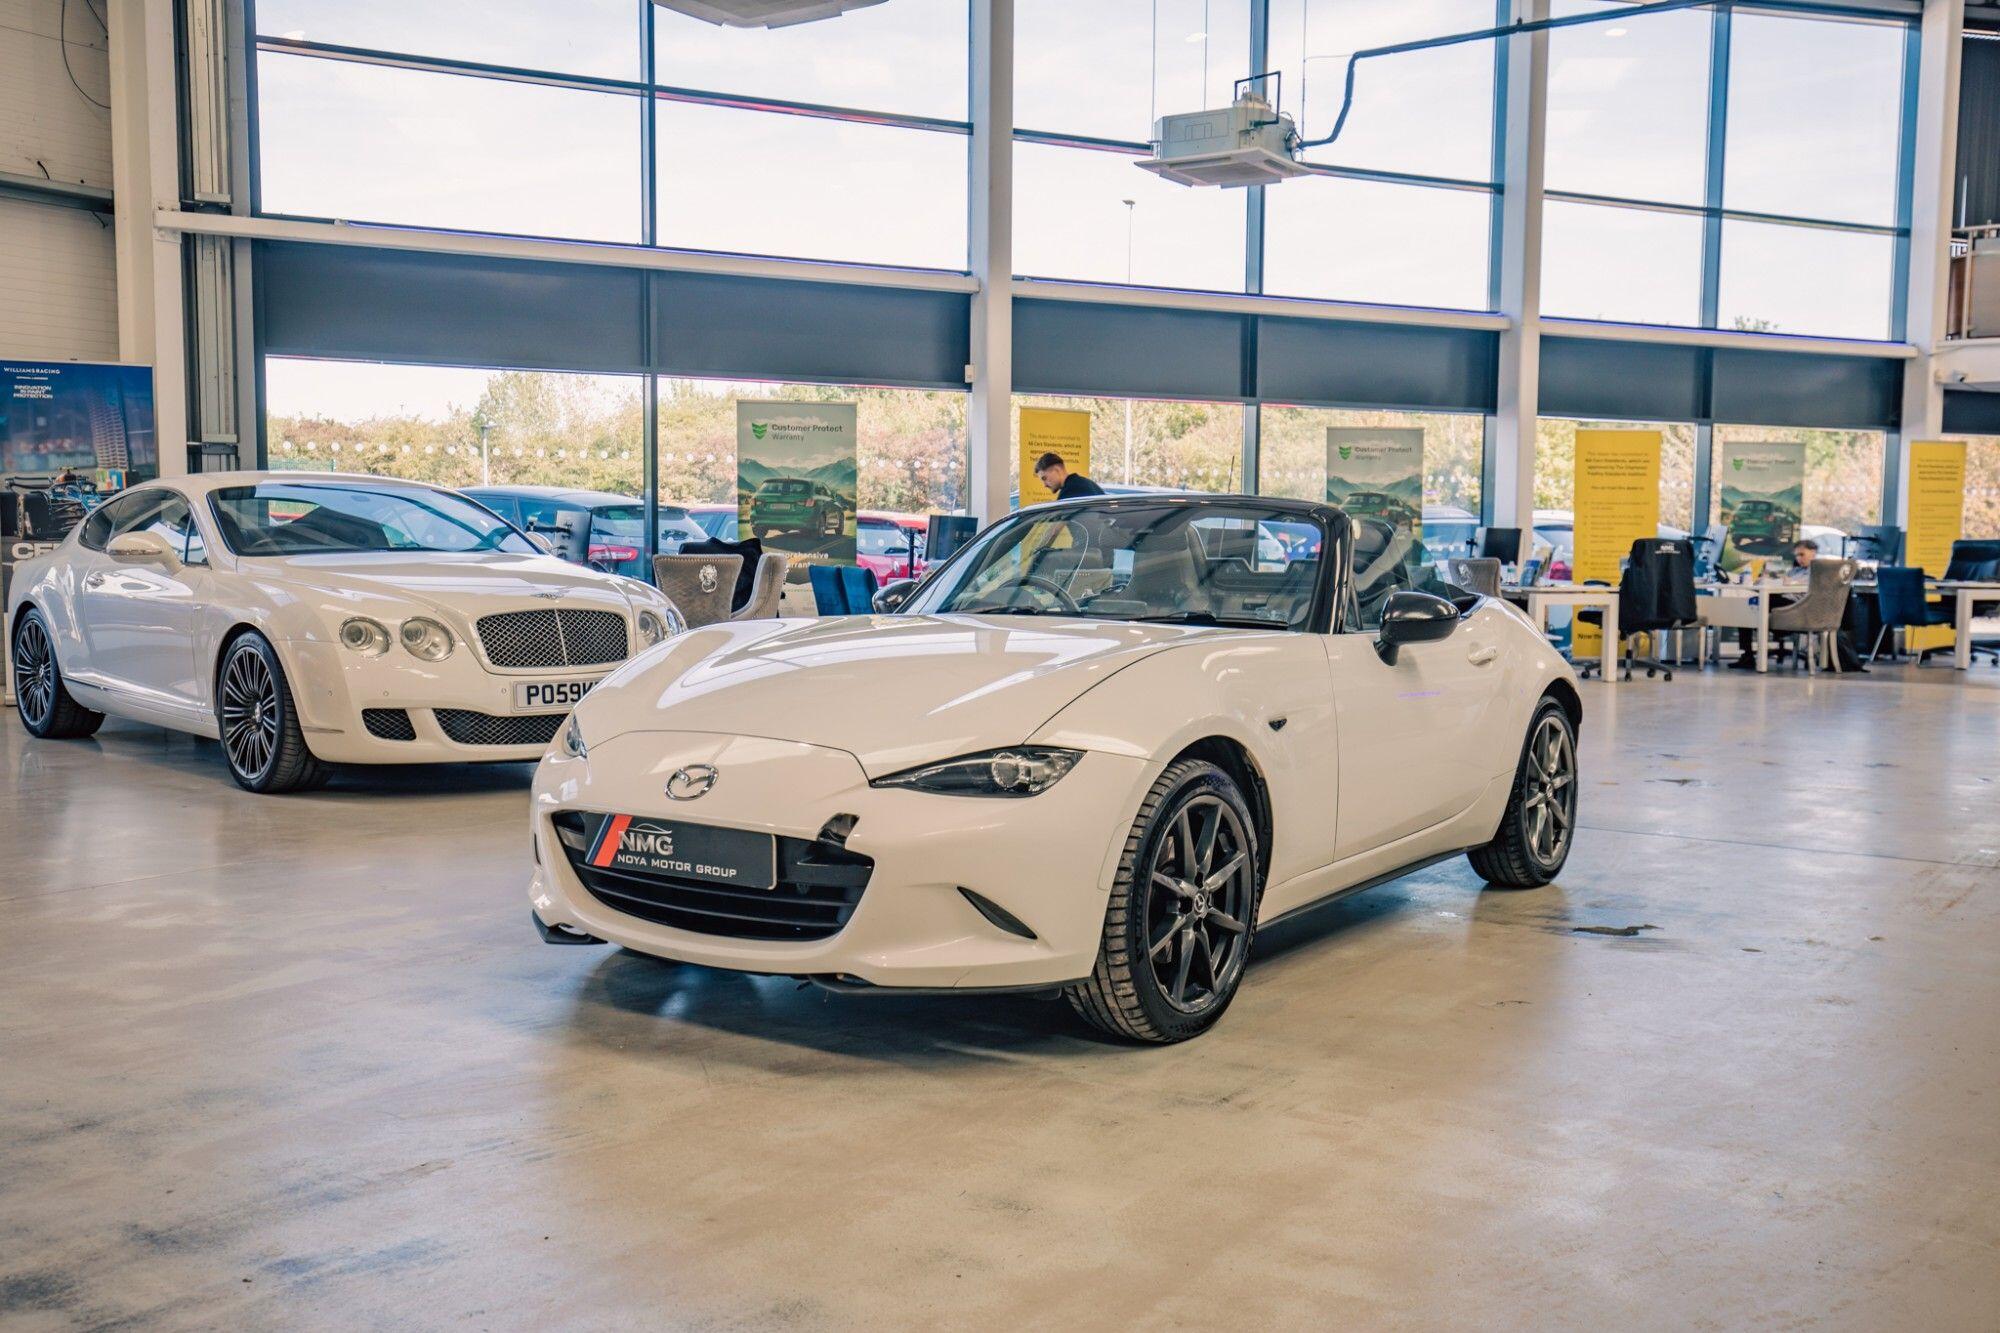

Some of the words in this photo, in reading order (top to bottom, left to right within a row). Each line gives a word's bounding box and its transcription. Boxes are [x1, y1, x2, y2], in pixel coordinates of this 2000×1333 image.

[771, 423, 811, 432] Customer
[812, 424, 843, 432] Protect
[771, 433, 805, 441] Warranty
[785, 551, 829, 560] prehensive
[618, 831, 674, 855] NMG
[617, 854, 647, 866] NOYA
[651, 858, 692, 872] MOTOR
[696, 864, 737, 878] GROUP
